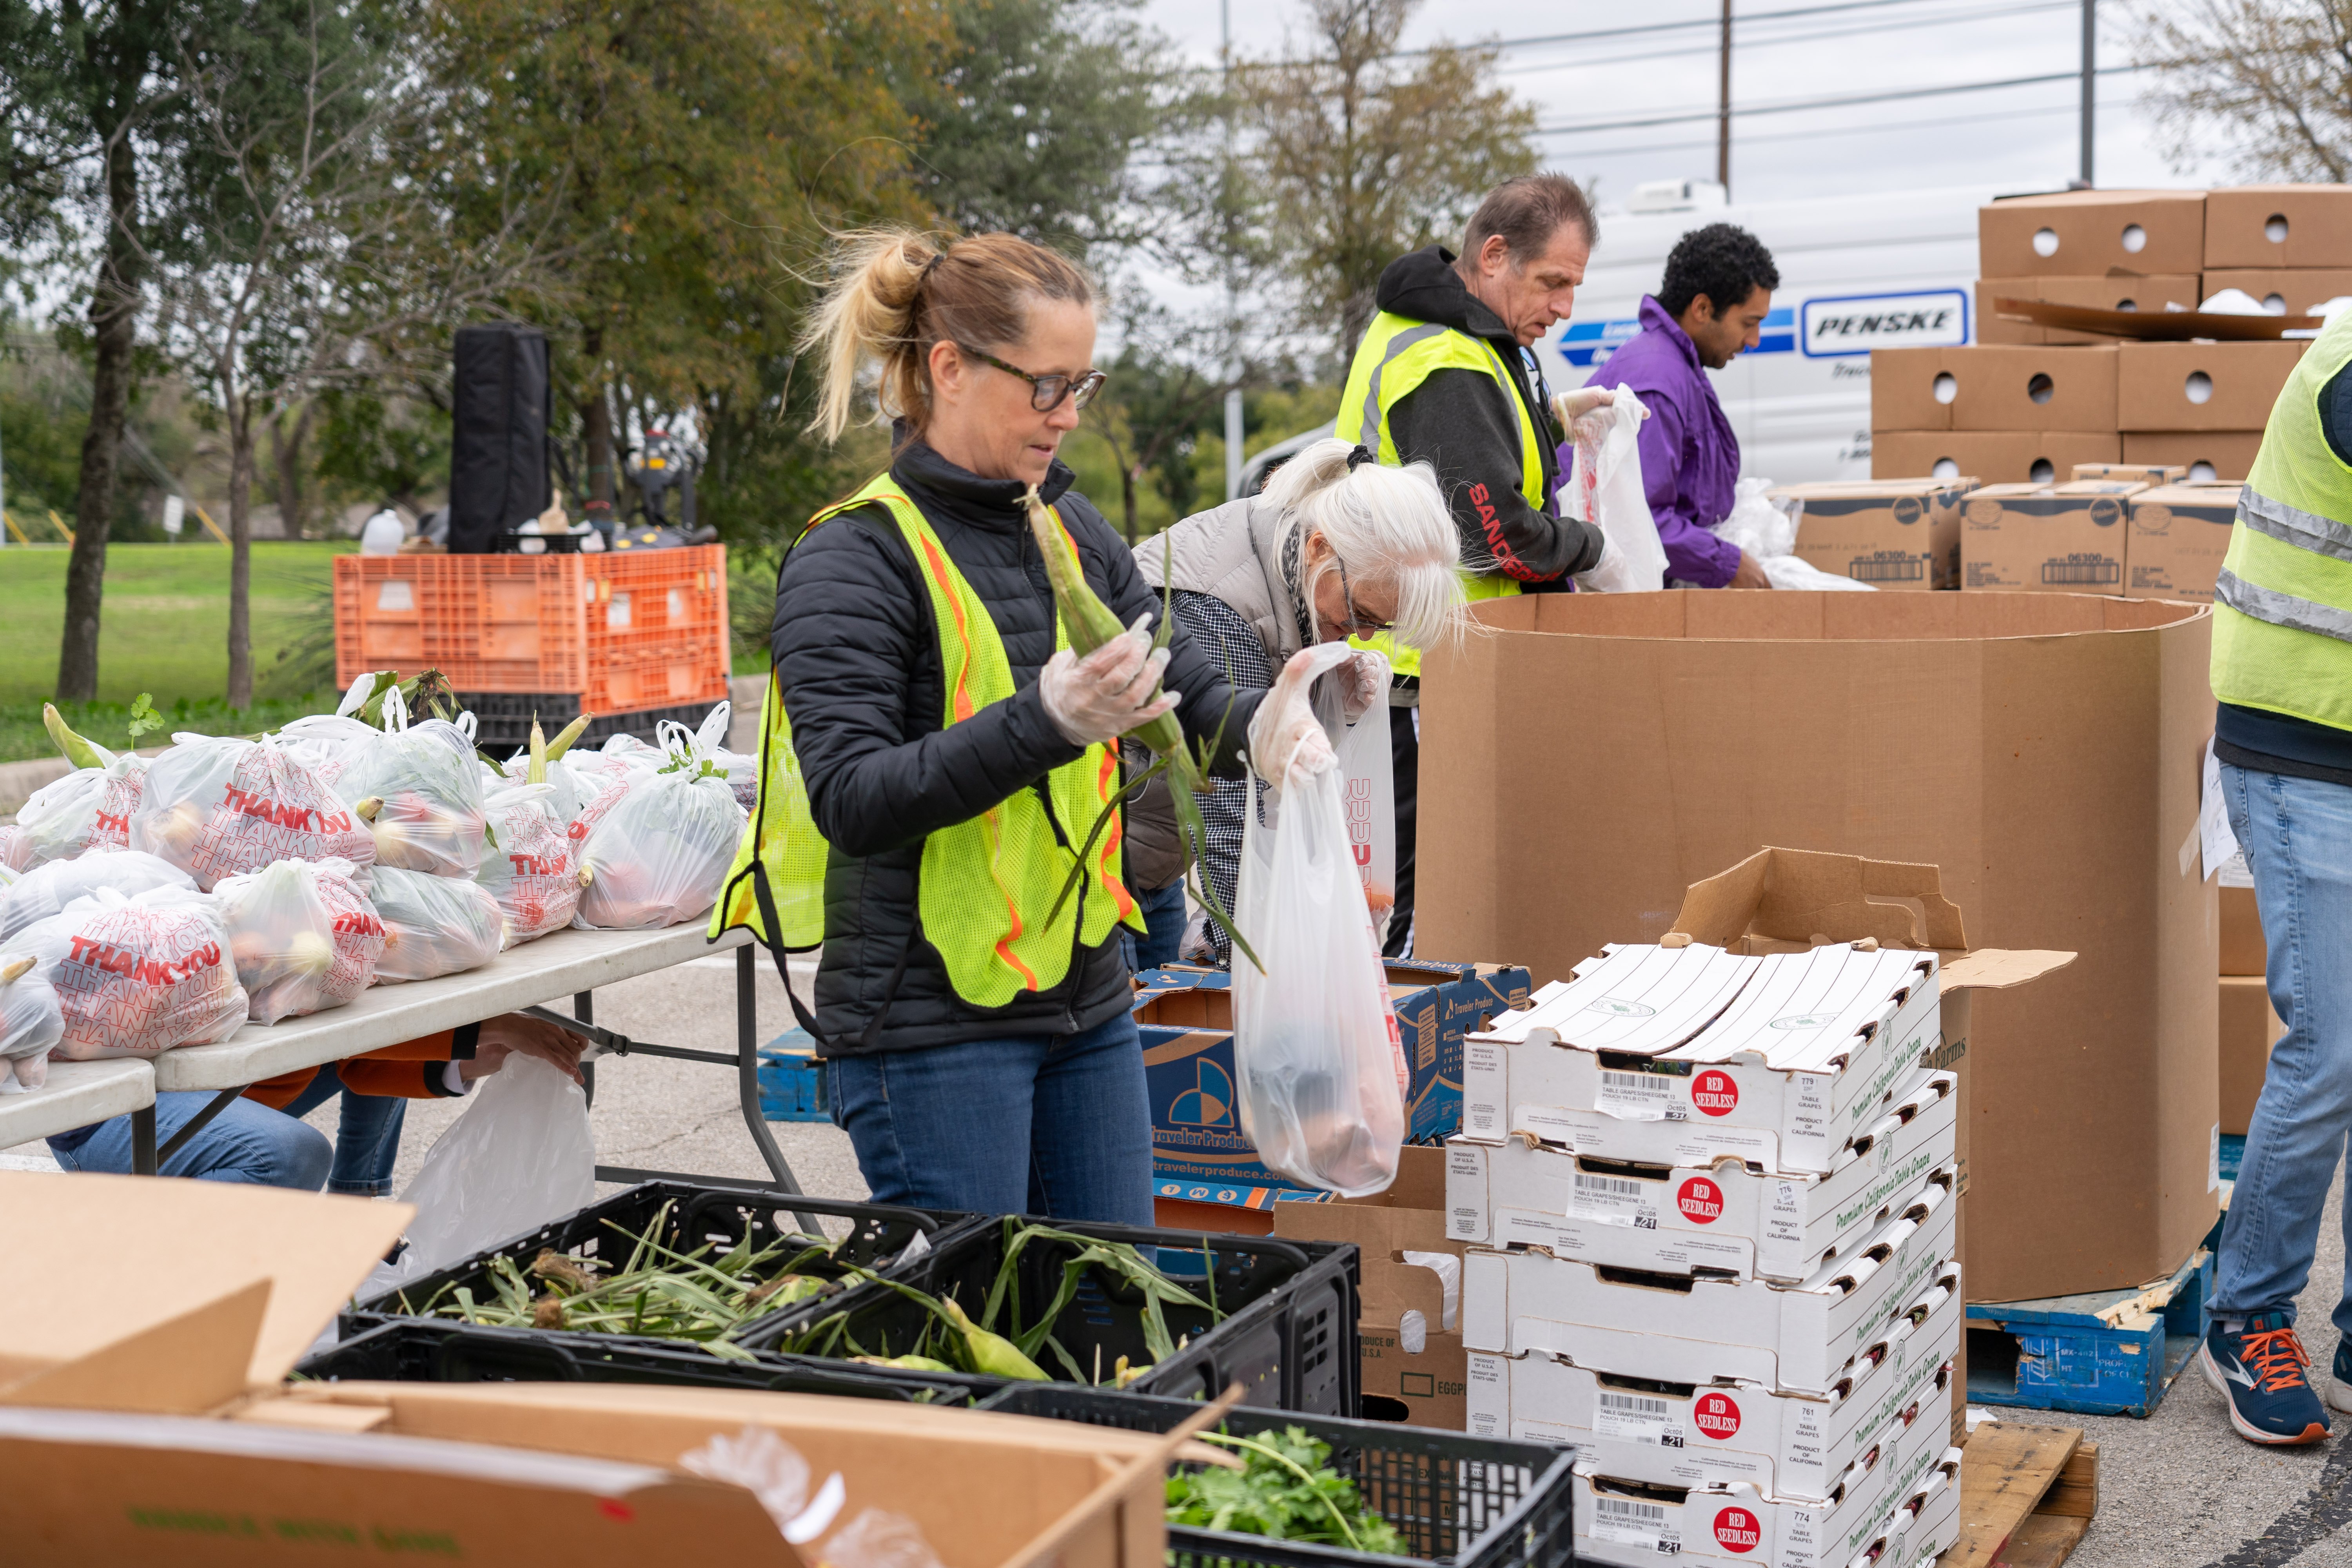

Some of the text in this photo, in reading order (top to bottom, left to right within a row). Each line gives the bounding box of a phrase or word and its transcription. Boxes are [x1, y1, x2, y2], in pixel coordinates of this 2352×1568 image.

[1815, 309, 1952, 337] PENSKE
[1874, 550, 1906, 561] 06300
[2068, 554, 2102, 563] 06300
[224, 782, 314, 832] THANK
[212, 803, 356, 856] THANK YOU
[70, 935, 220, 985] THANK YOU
[60, 958, 223, 1011] THANK YOU
[54, 983, 224, 1031] THANK YOU
[1455, 999, 1474, 1015] Traveler
[1475, 996, 1493, 1009] Produce
[1447, 1033, 1463, 1043] TOMATOES
[1706, 1076, 1723, 1091] RED
[1852, 1091, 1871, 1124] Premium
[1873, 1062, 1895, 1099] California
[1907, 1036, 1921, 1063] Grape
[1695, 1093, 1735, 1108] SEEDLESS
[1203, 1130, 1256, 1150] Produc
[1792, 1129, 1825, 1138] CALIFORNIA
[1693, 1183, 1710, 1200] RED
[1779, 1185, 1791, 1195] 776
[1836, 1202, 1863, 1232] Premium
[1865, 1175, 1895, 1210] California
[1911, 1152, 1930, 1178] Grape
[1681, 1198, 1720, 1218] SEEDLESS
[1771, 1220, 1798, 1228] PRODUCT
[1767, 1232, 1800, 1242] CALIFORNIA
[1386, 1338, 1395, 1348] OF
[1362, 1348, 1383, 1358] U.S.A.
[1709, 1398, 1726, 1414] RED
[1855, 1413, 1879, 1448] Premium
[1882, 1381, 1907, 1420] California
[1923, 1350, 1940, 1379] Grape
[1802, 1407, 1814, 1416] 761
[1698, 1413, 1737, 1432] SEEDLESS
[1668, 1437, 1681, 1447] 21
[1793, 1444, 1820, 1453] PRODUCT
[1789, 1457, 1822, 1466] CALIFORNIA
[1849, 1517, 1872, 1553] Premium
[1874, 1482, 1900, 1522] California
[1914, 1450, 1931, 1478] Grape
[1729, 1512, 1746, 1528] RED
[1794, 1511, 1809, 1523] 774
[1661, 1533, 1680, 1541] Oct05
[1717, 1528, 1757, 1546] SEEDLESS
[1789, 1535, 1813, 1544] GRAPES
[1666, 1541, 1678, 1552] 21
[1786, 1550, 1813, 1559] PRODUCT
